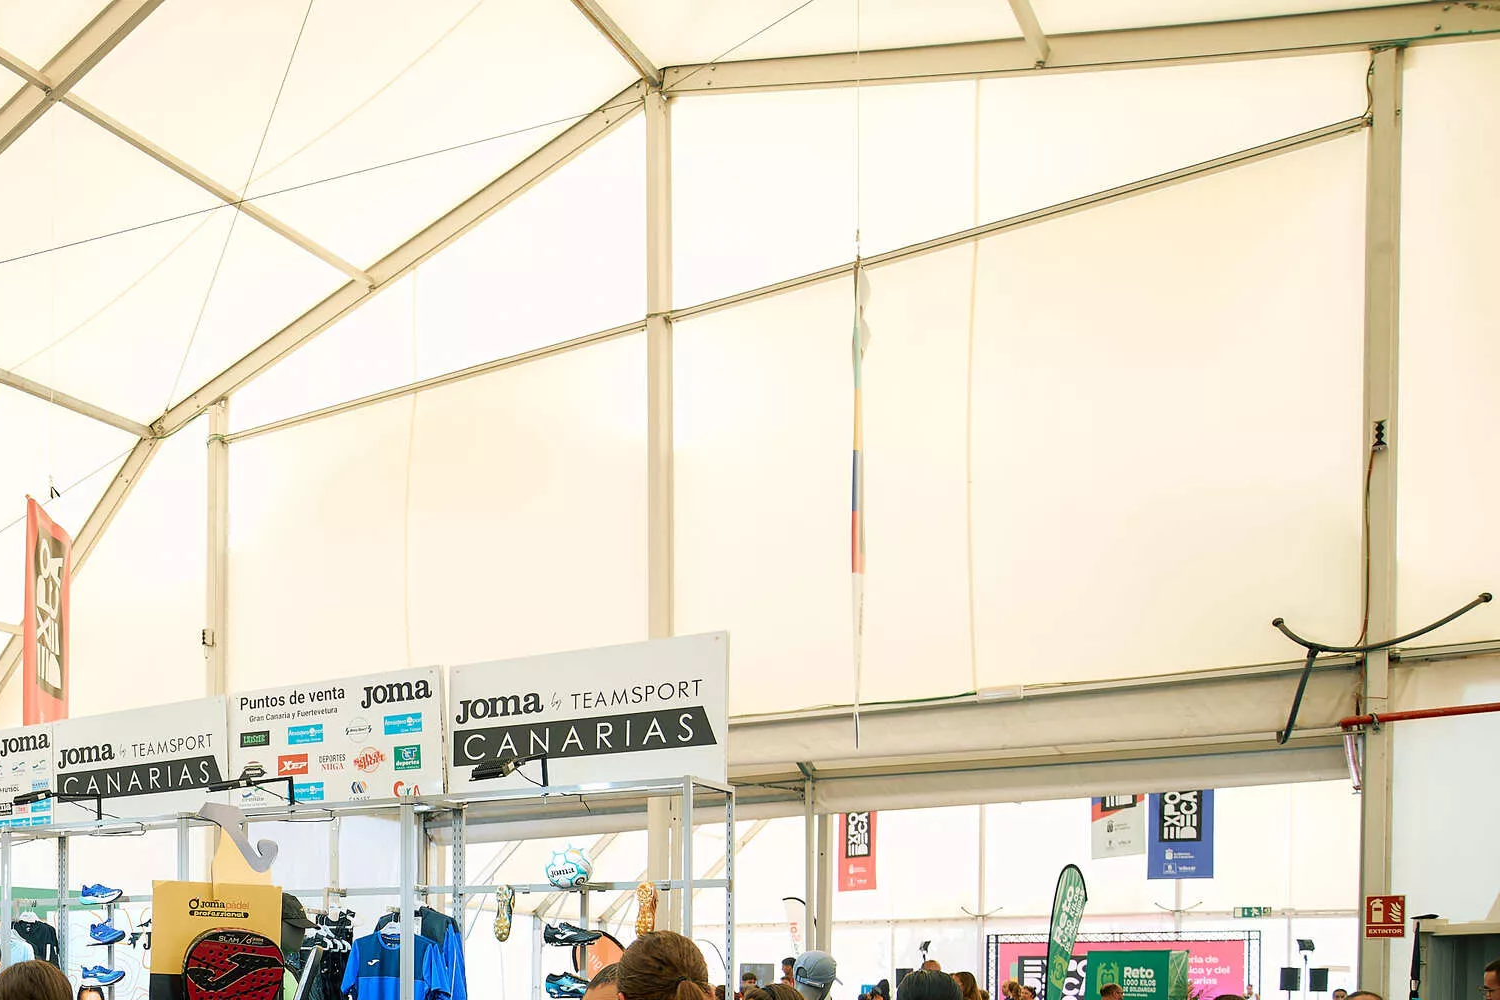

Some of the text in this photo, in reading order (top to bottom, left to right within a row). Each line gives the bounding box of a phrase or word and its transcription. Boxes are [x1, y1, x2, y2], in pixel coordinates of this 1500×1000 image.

[240, 695, 286, 710] Puntos
[289, 690, 305, 705] de
[309, 687, 345, 702] venta
[550, 692, 563, 712] by
[570, 679, 704, 710] TEAMSPORT
[249, 715, 265, 723] Gran
[266, 712, 291, 721] Canaria
[131, 733, 213, 758] TEAMSPORT
[463, 714, 694, 760] CANARIAS
[319, 754, 346, 763] DEPORTES
[64, 761, 210, 794] CANARIAS
[1163, 791, 1180, 839] EXPO
[1180, 791, 1197, 838] DECA
[218, 935, 240, 943] SLAM
[1205, 955, 1219, 963] de
[1214, 966, 1231, 974] del
[1124, 967, 1155, 978] Reto
